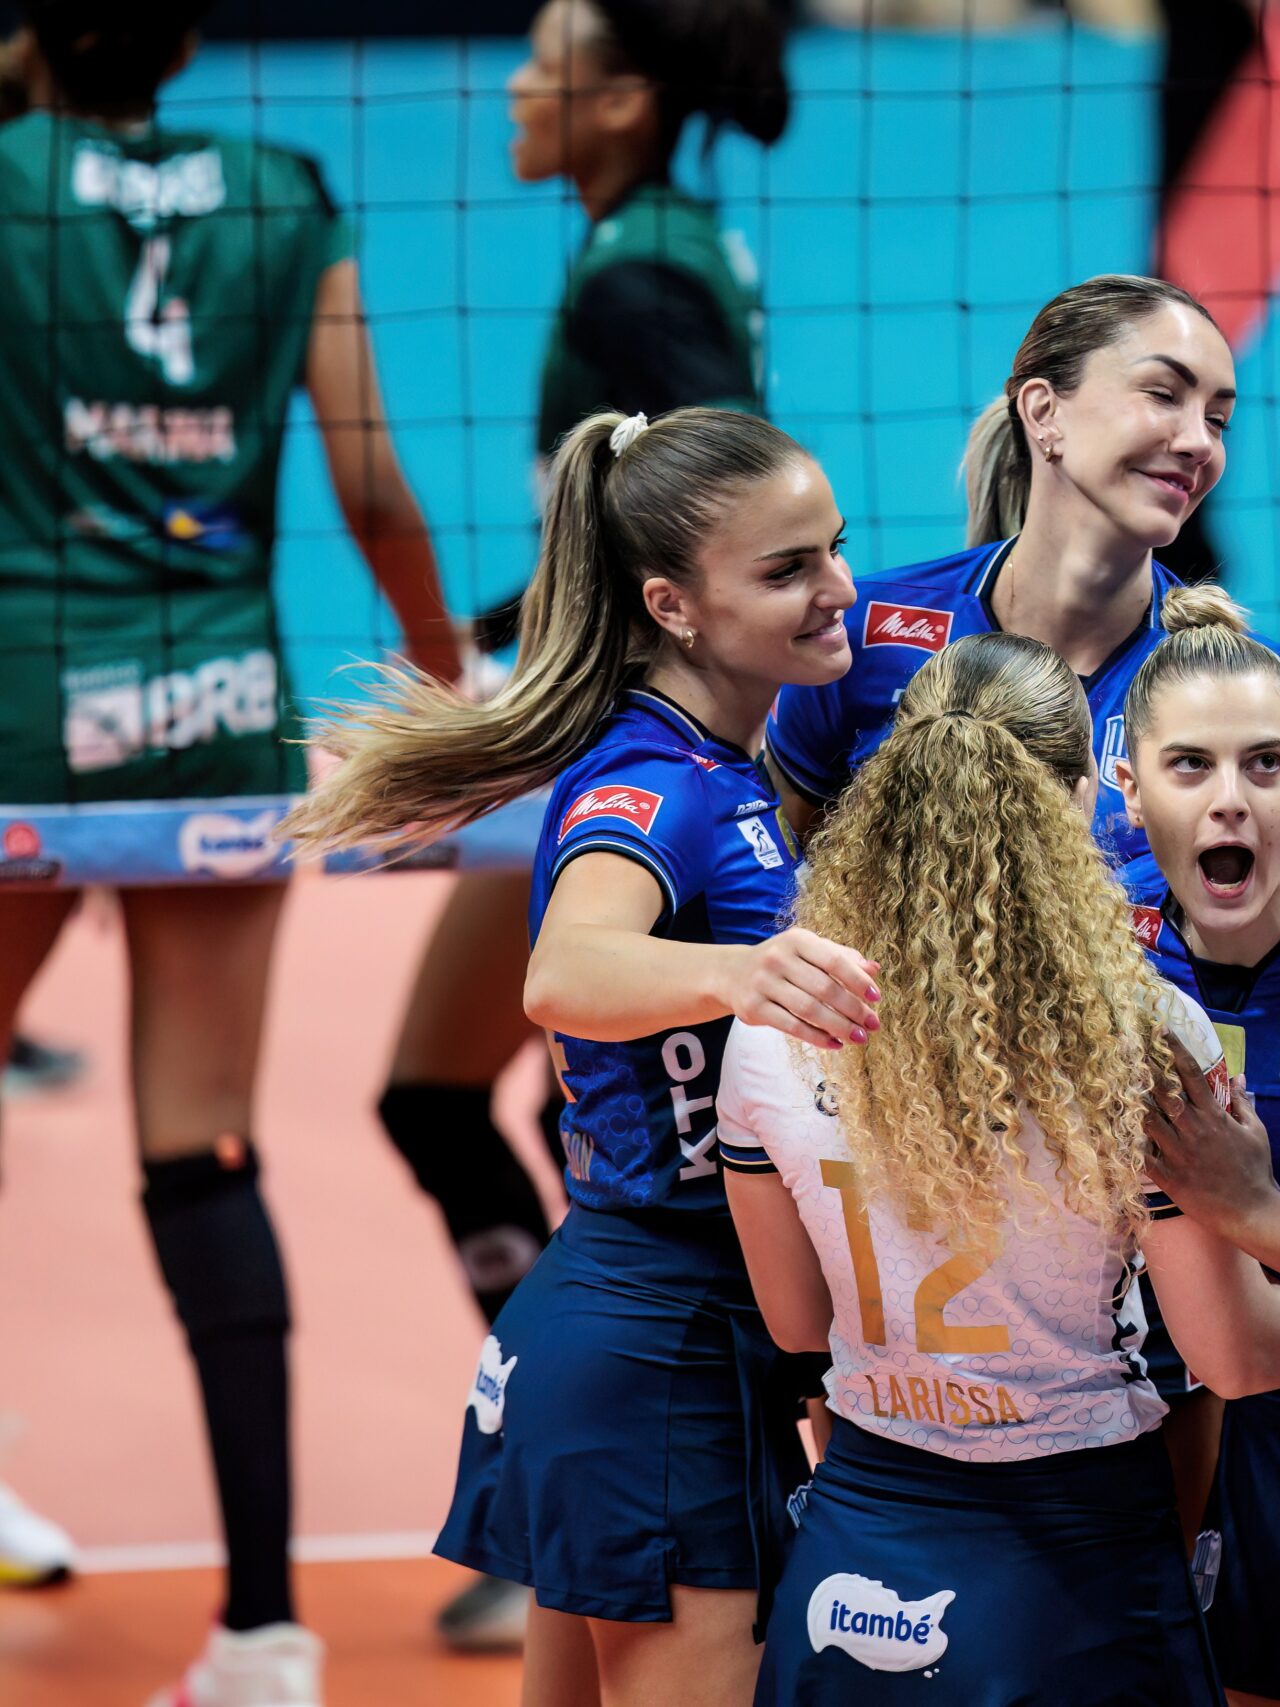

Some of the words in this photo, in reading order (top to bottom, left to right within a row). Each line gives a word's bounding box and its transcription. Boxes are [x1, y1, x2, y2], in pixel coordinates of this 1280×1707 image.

[873, 610, 938, 642] Melitta
[818, 1158, 1011, 1354] 12
[864, 1374, 1026, 1426] LARISSA
[830, 1599, 932, 1645] itambé
